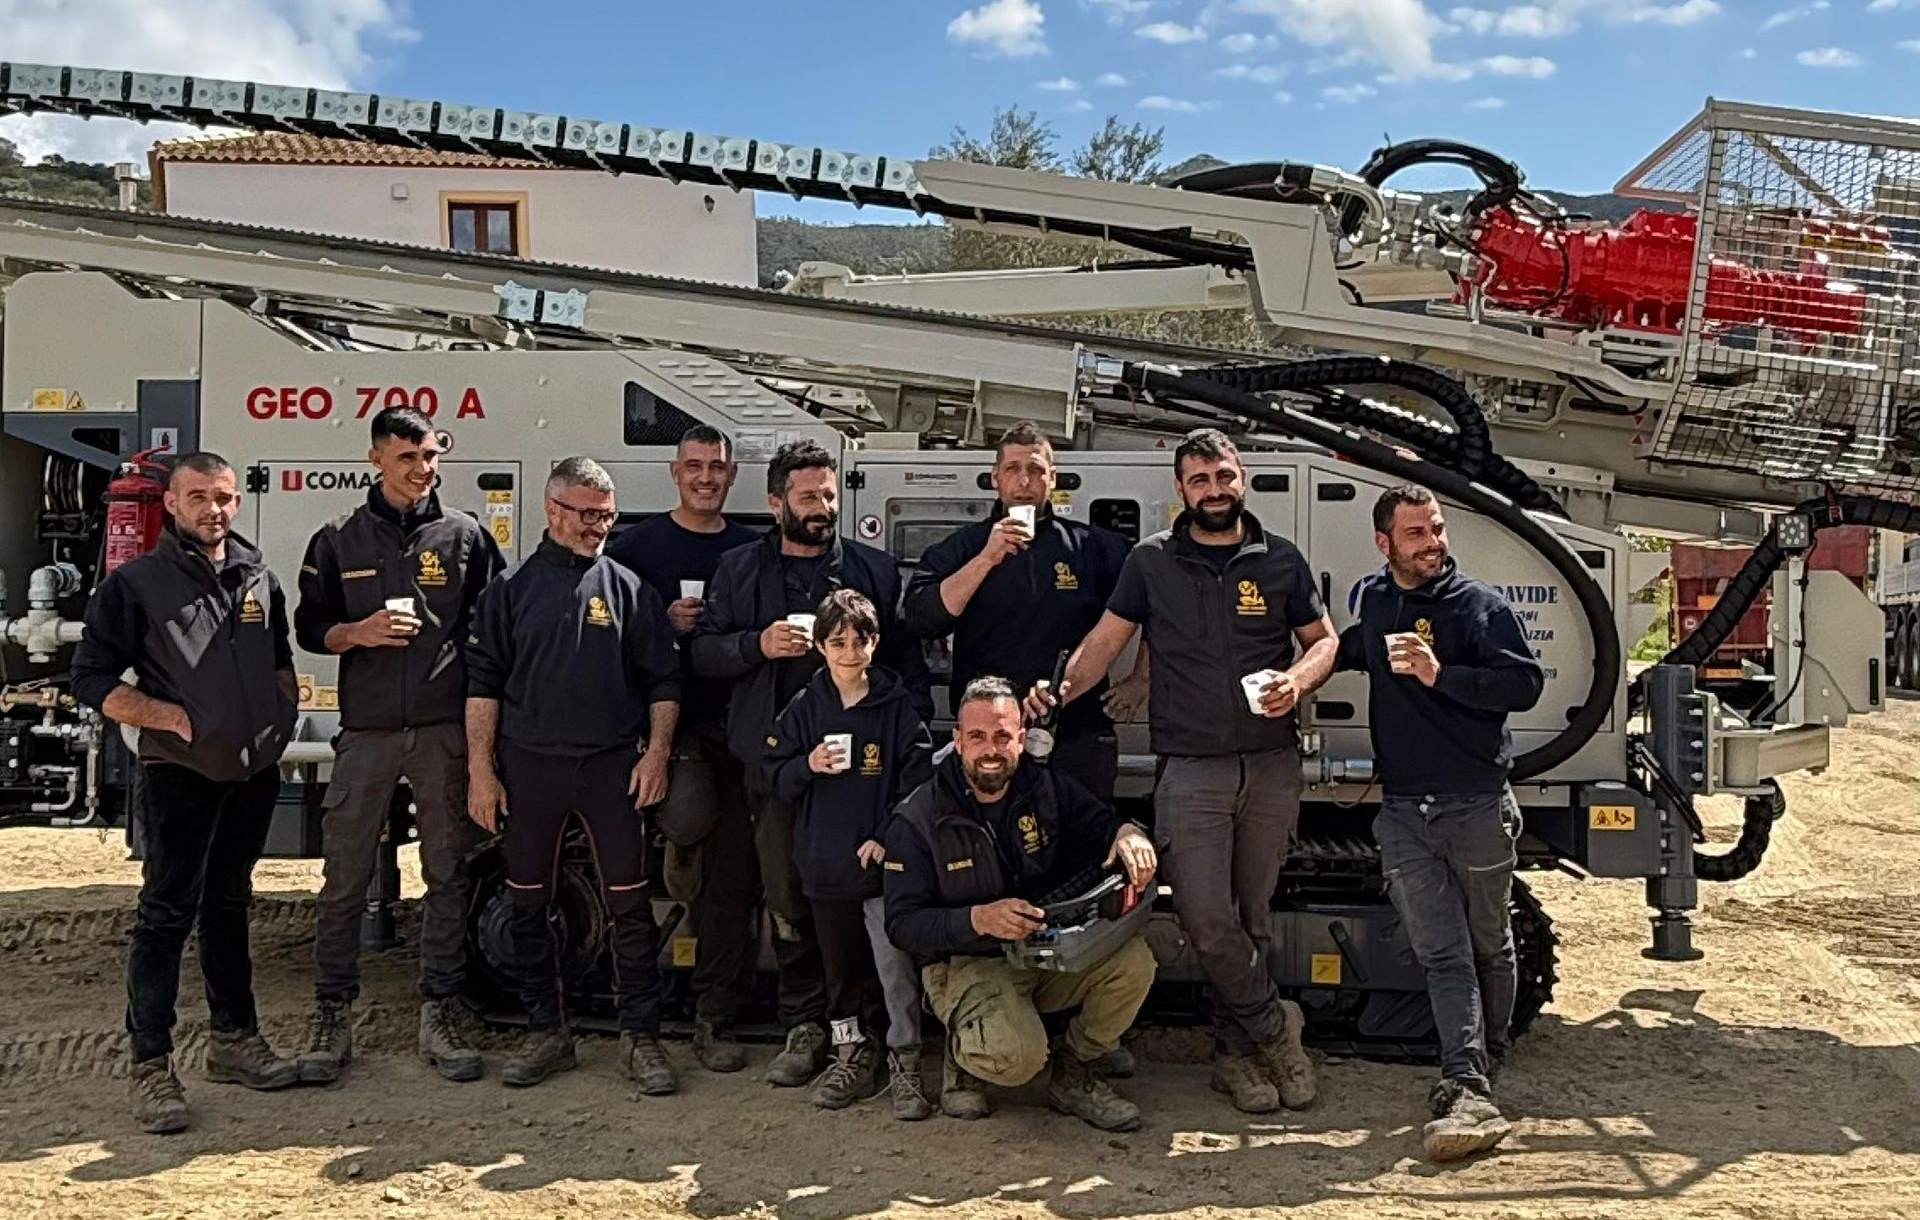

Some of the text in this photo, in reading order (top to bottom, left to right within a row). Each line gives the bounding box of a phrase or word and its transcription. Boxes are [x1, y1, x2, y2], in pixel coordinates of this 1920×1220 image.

[246, 386, 486, 419] GEO 700 A
